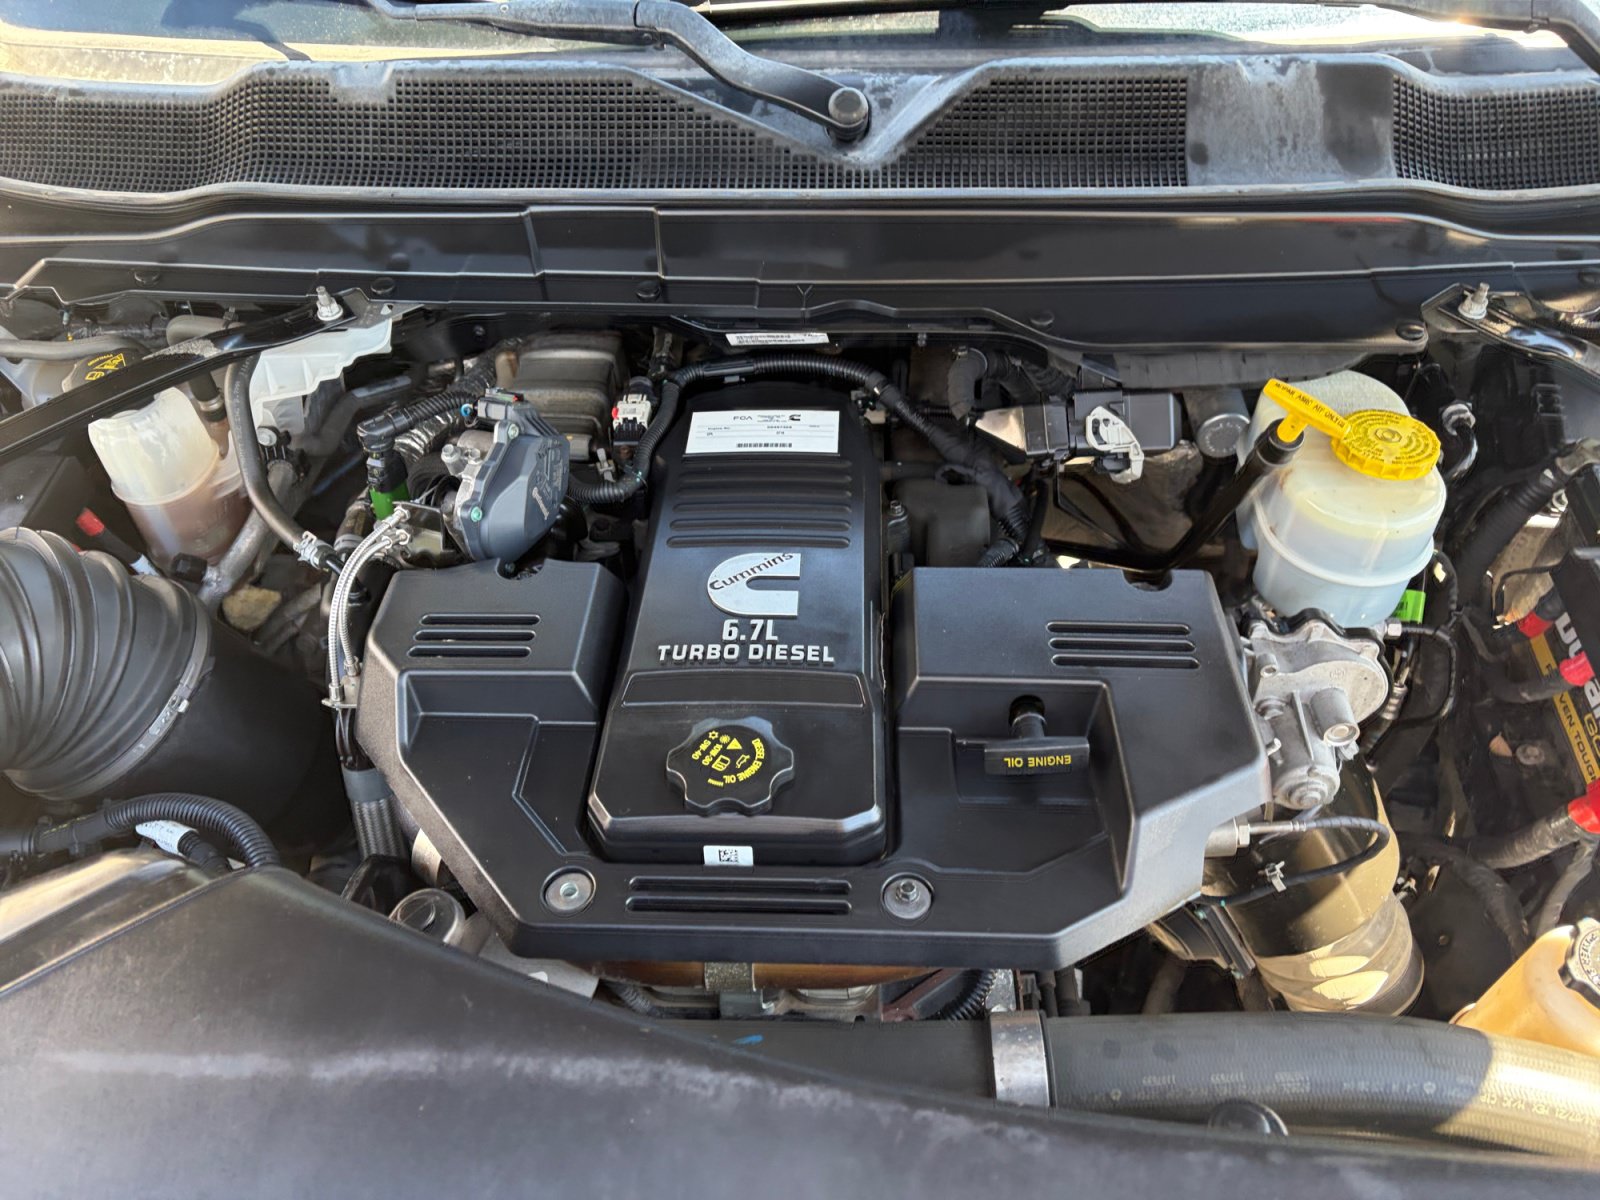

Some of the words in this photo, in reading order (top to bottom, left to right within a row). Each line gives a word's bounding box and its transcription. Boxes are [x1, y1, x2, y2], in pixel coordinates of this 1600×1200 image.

[709, 553, 794, 590] Cummins
[722, 619, 778, 641] 6.7L
[658, 644, 740, 661] TURBO
[748, 644, 834, 662] DIESEL
[691, 739, 711, 760] 5W-40
[702, 744, 722, 766] 10W-30
[736, 760, 762, 782] ENGINE
[1004, 757, 1023, 768] OIL
[1028, 755, 1071, 767] ENGINE
[723, 775, 736, 784] OIL
